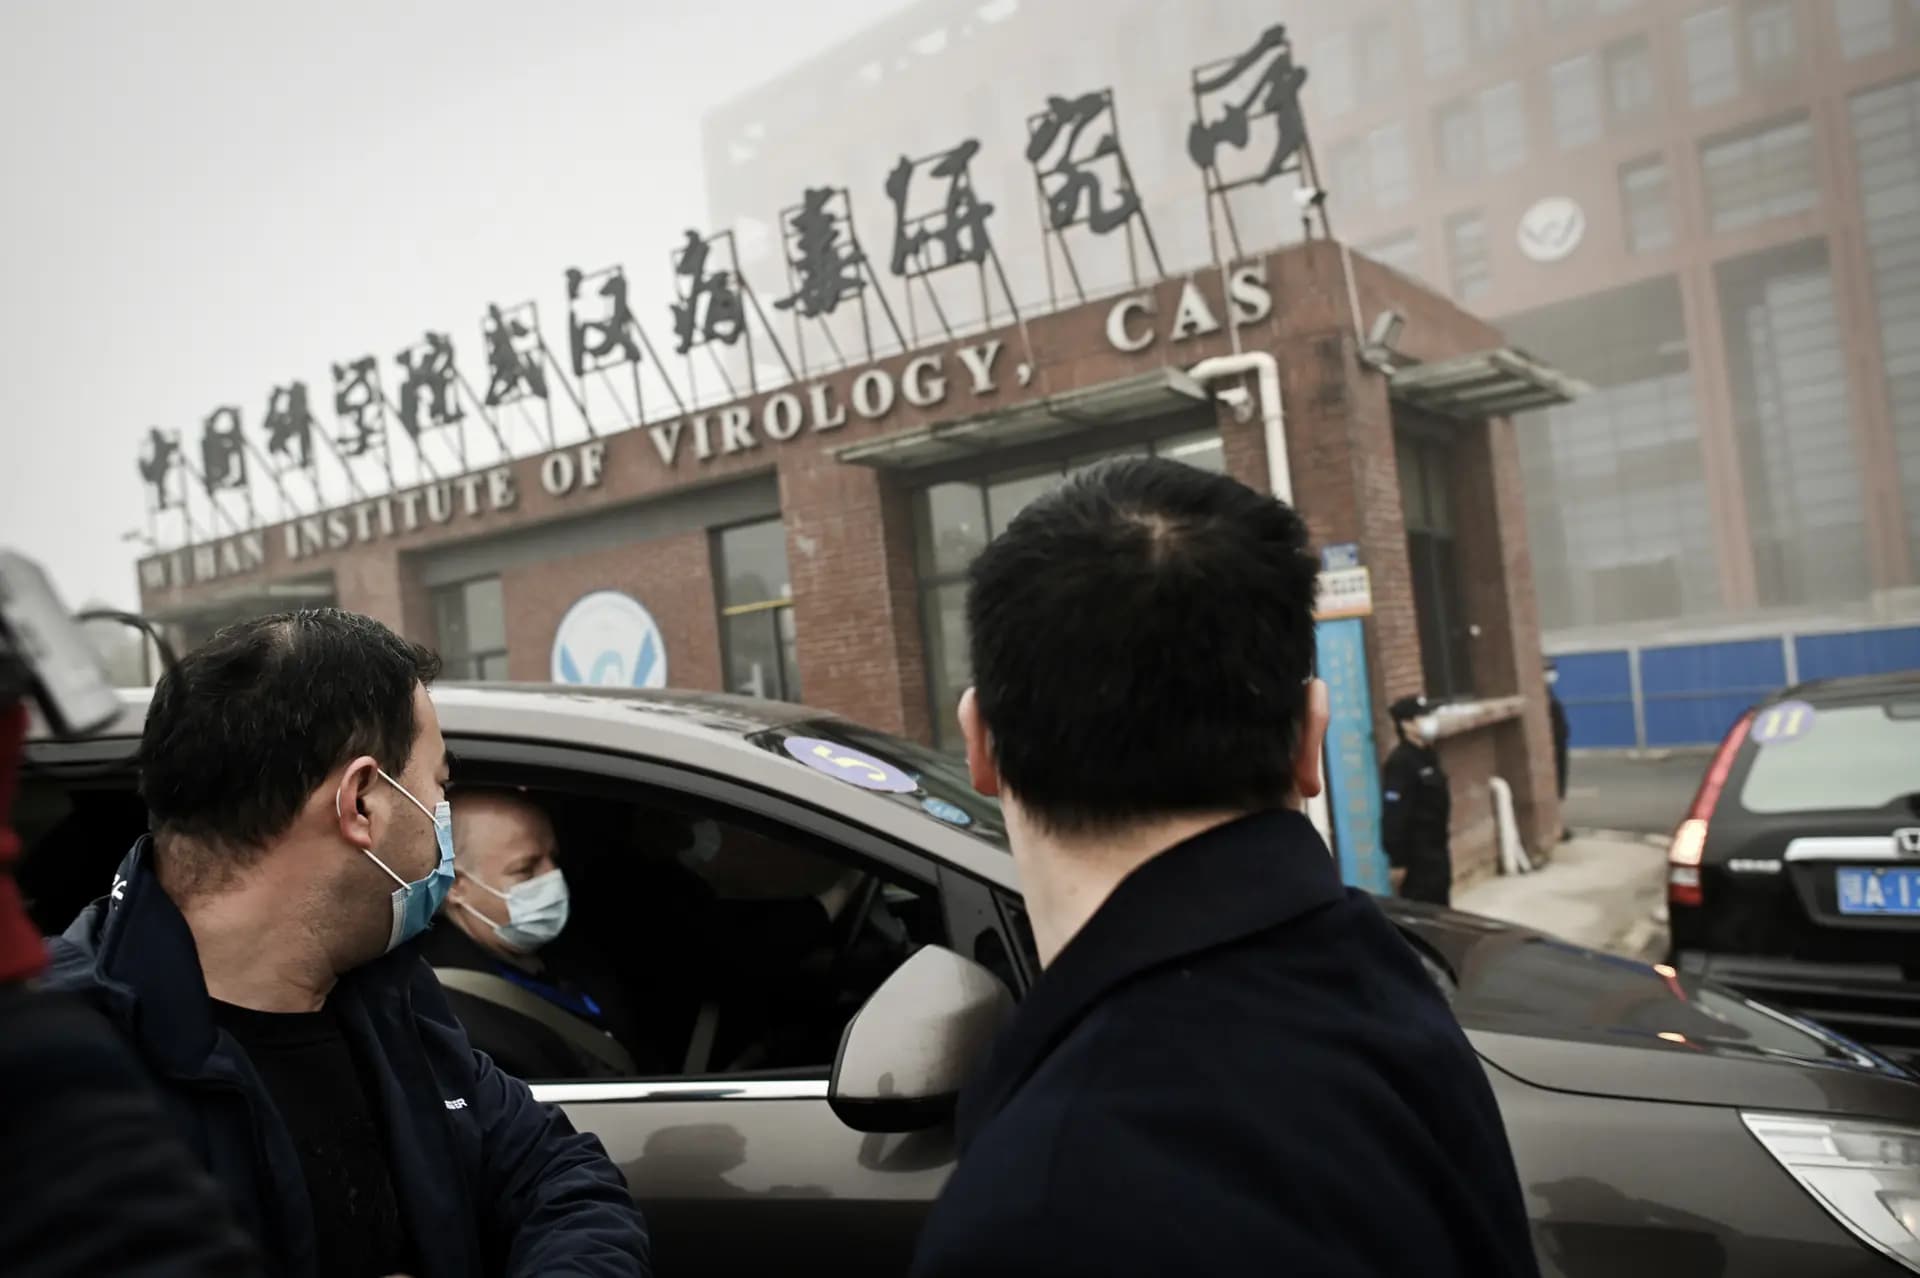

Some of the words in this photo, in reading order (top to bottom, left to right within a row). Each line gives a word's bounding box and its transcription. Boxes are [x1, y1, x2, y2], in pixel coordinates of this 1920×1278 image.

[284, 467, 516, 560] INSTITUTE
[541, 443, 607, 495] OF
[648, 339, 1034, 466] VIROLOGY,
[1106, 264, 1275, 352] CAS
[1764, 709, 1804, 738] 11
